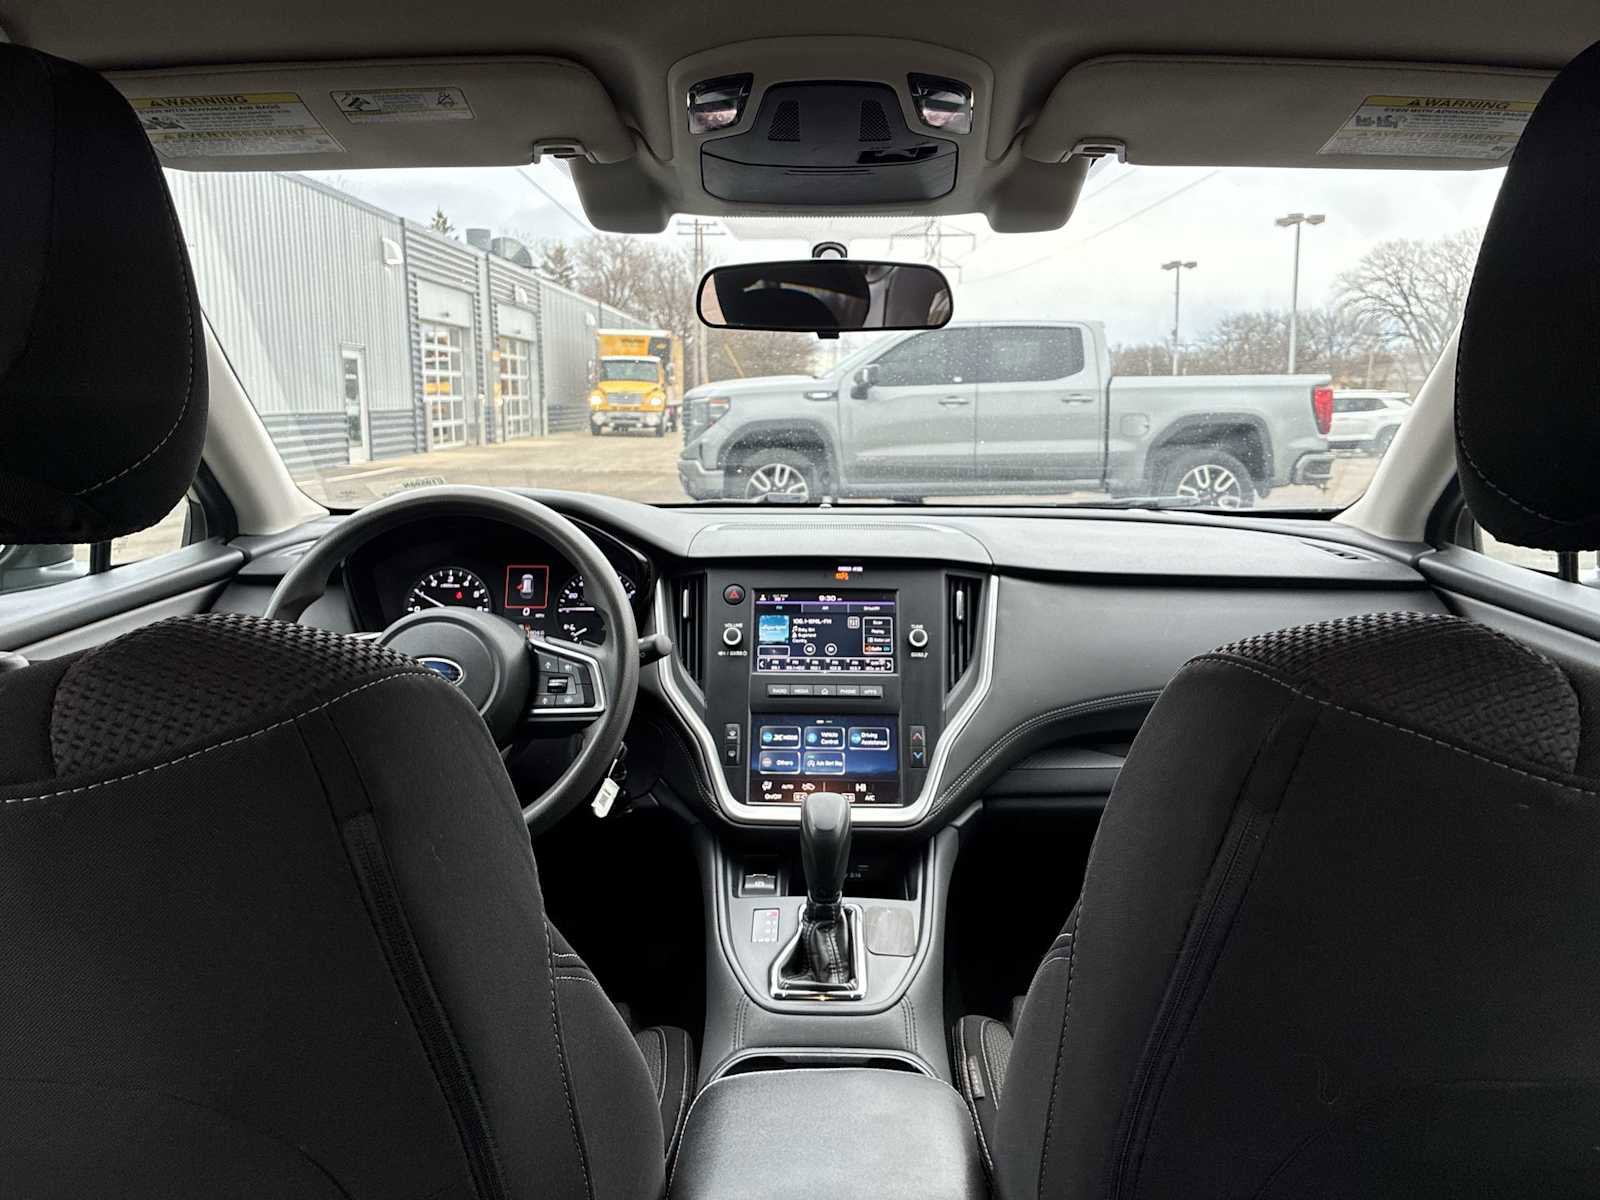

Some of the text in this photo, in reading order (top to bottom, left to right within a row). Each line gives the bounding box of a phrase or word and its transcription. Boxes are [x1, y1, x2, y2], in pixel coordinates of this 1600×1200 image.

[162, 95, 249, 106] WARNING
[1424, 97, 1510, 110] WARNING
[522, 607, 530, 616] 0
[860, 732, 878, 740] Driving
[855, 783, 867, 792] HI
